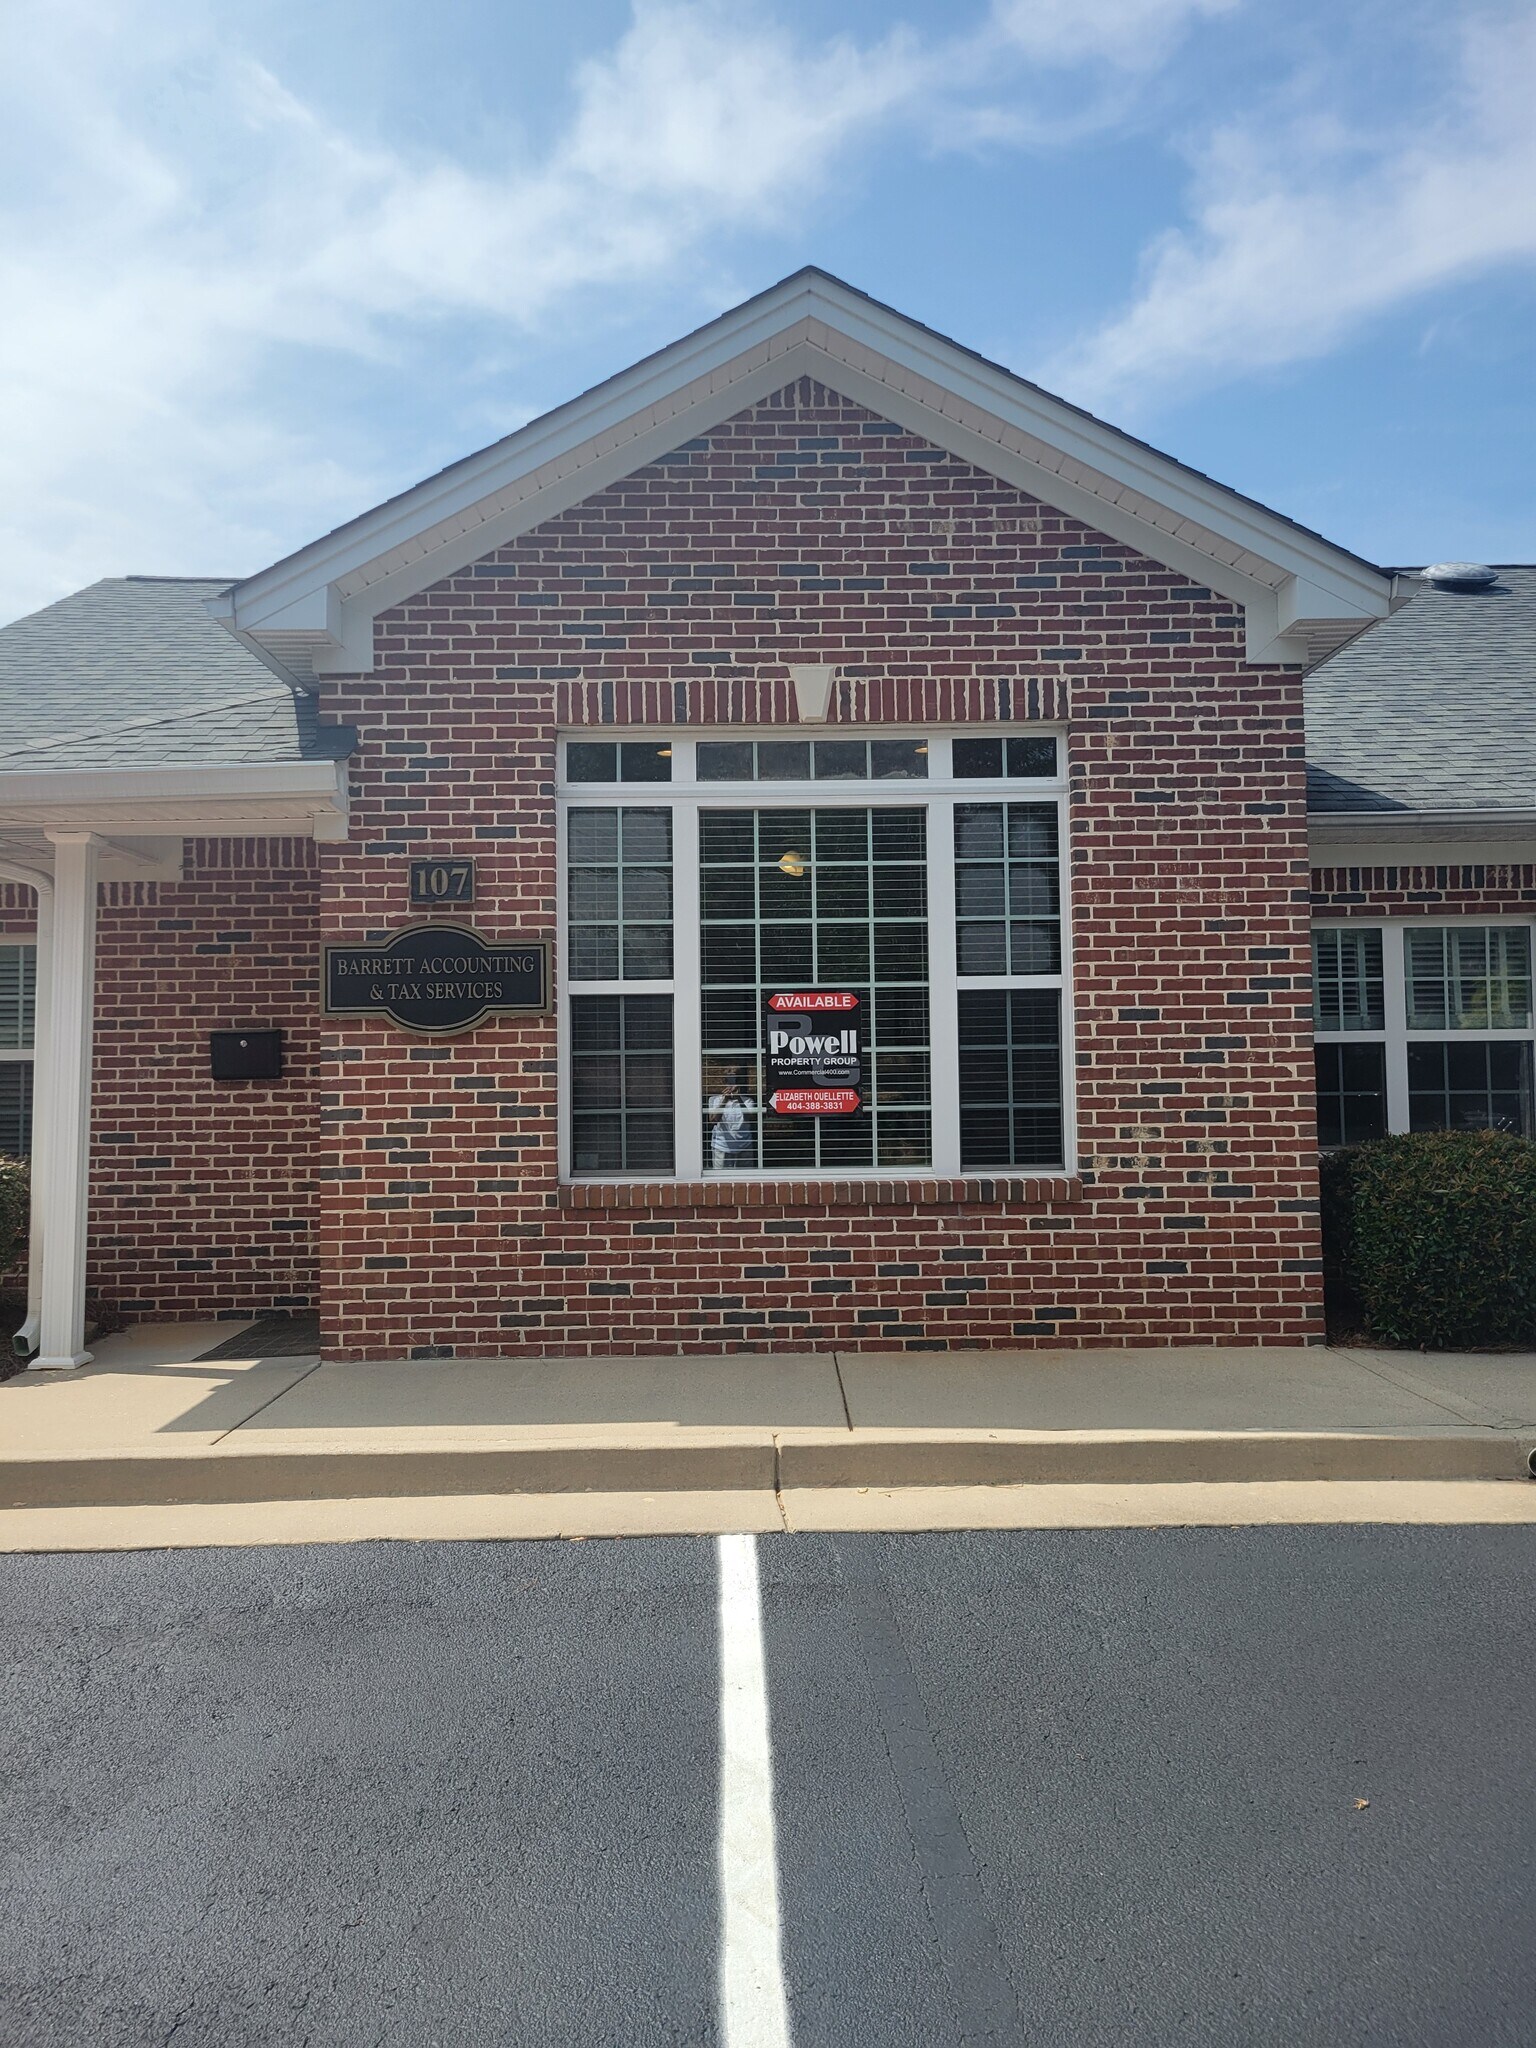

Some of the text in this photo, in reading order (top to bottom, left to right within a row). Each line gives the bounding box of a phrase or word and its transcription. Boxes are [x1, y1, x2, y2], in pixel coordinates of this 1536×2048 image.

[415, 867, 469, 897] 107
[337, 955, 535, 976] BARRETT ACCOUNTING
[369, 981, 503, 1000] & TAX SERVICES
[775, 995, 852, 1008] AVAILABLE
[769, 1030, 858, 1055] Powell
[771, 1057, 857, 1066] PROPERTY GROUP
[778, 1068, 850, 1076] www.Commercial400.com
[775, 1091, 854, 1101] ELIZABETH OUELLETTE
[786, 1101, 844, 1110] 404-388-3831
